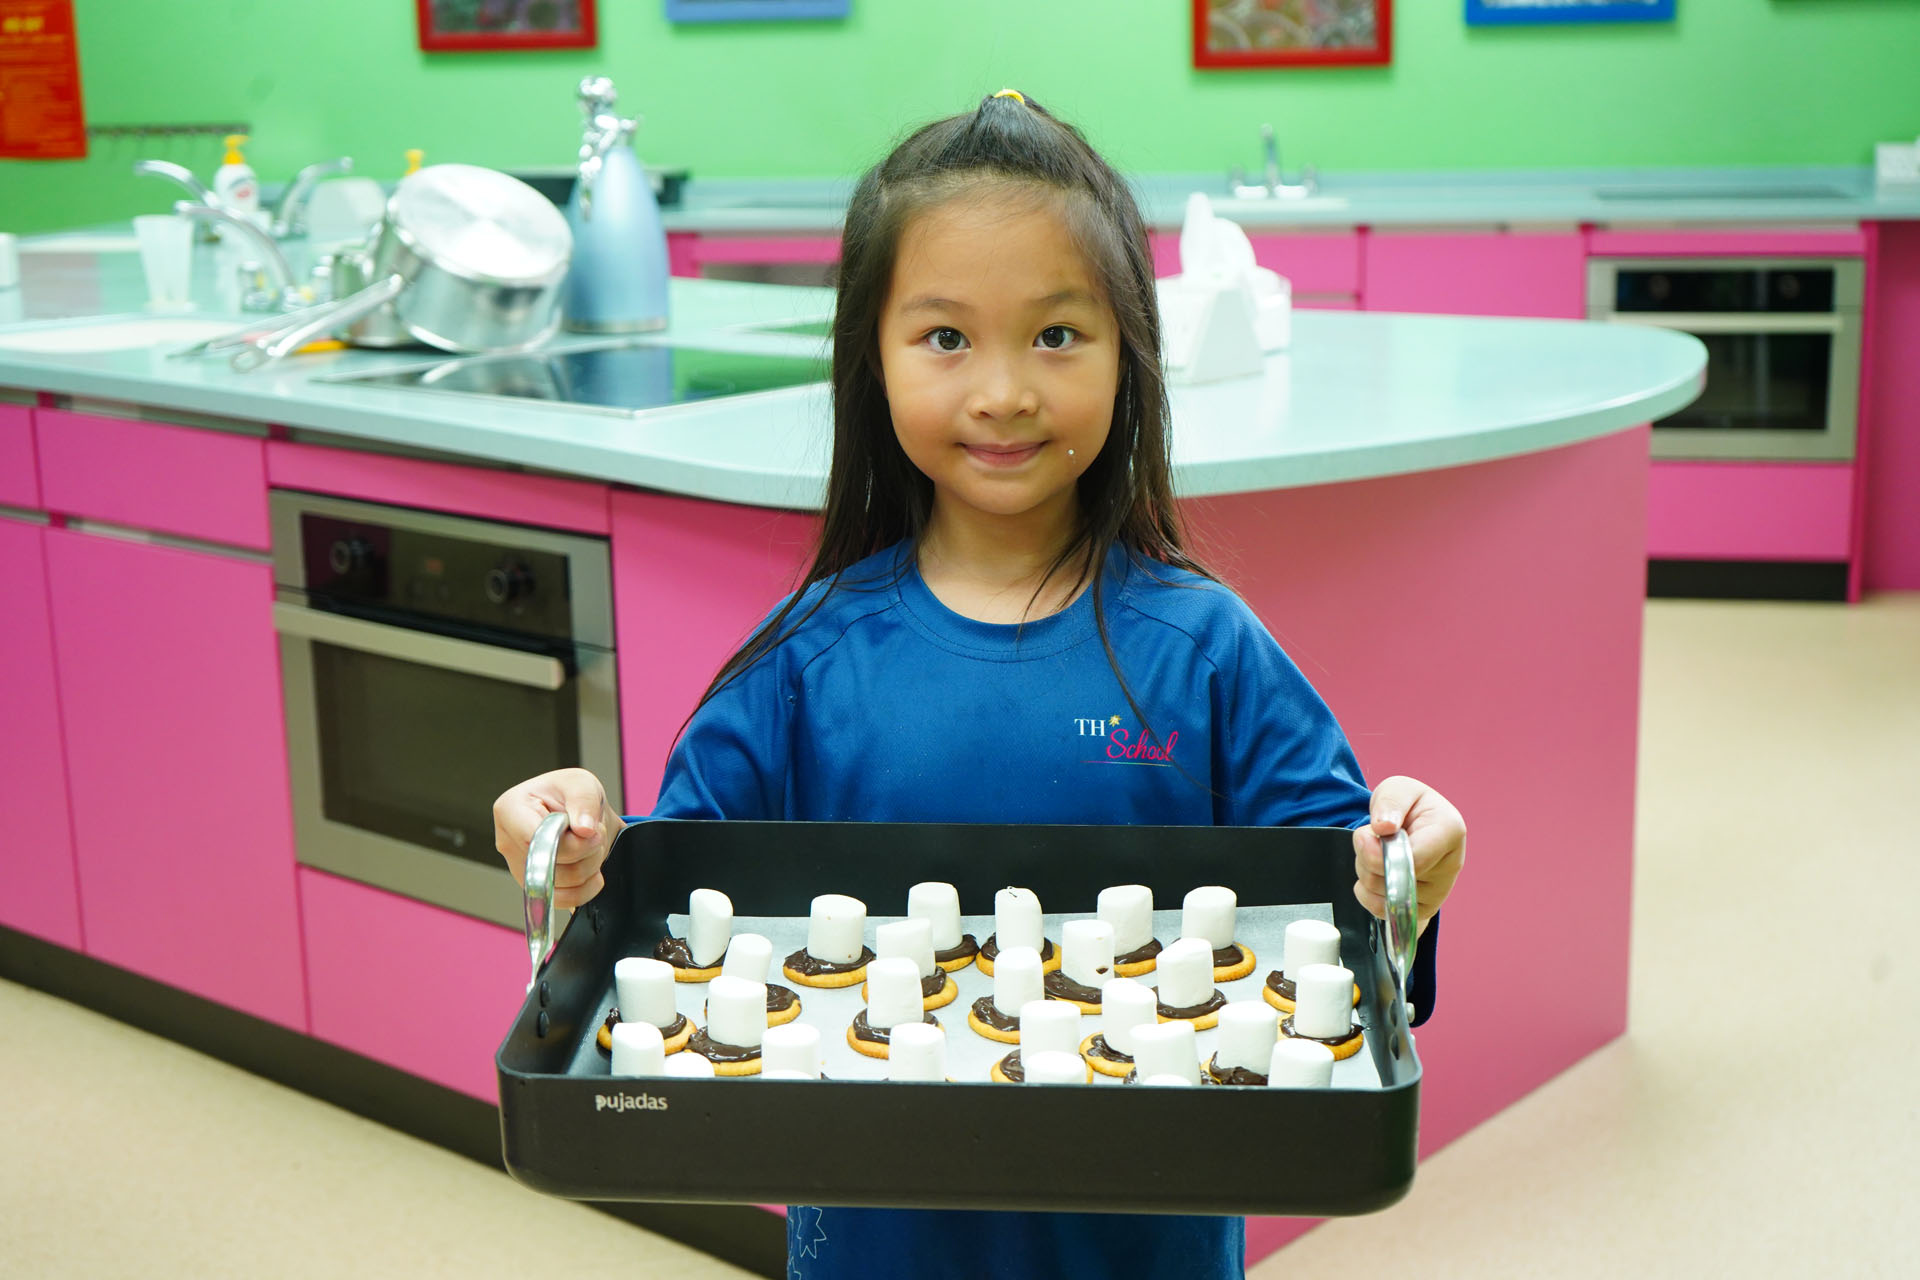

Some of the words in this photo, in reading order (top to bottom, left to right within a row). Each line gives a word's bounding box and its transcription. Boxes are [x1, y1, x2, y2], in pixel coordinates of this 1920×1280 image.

[1074, 718, 1106, 736] TH
[1106, 728, 1179, 761] School
[595, 1092, 668, 1112] pujadas
